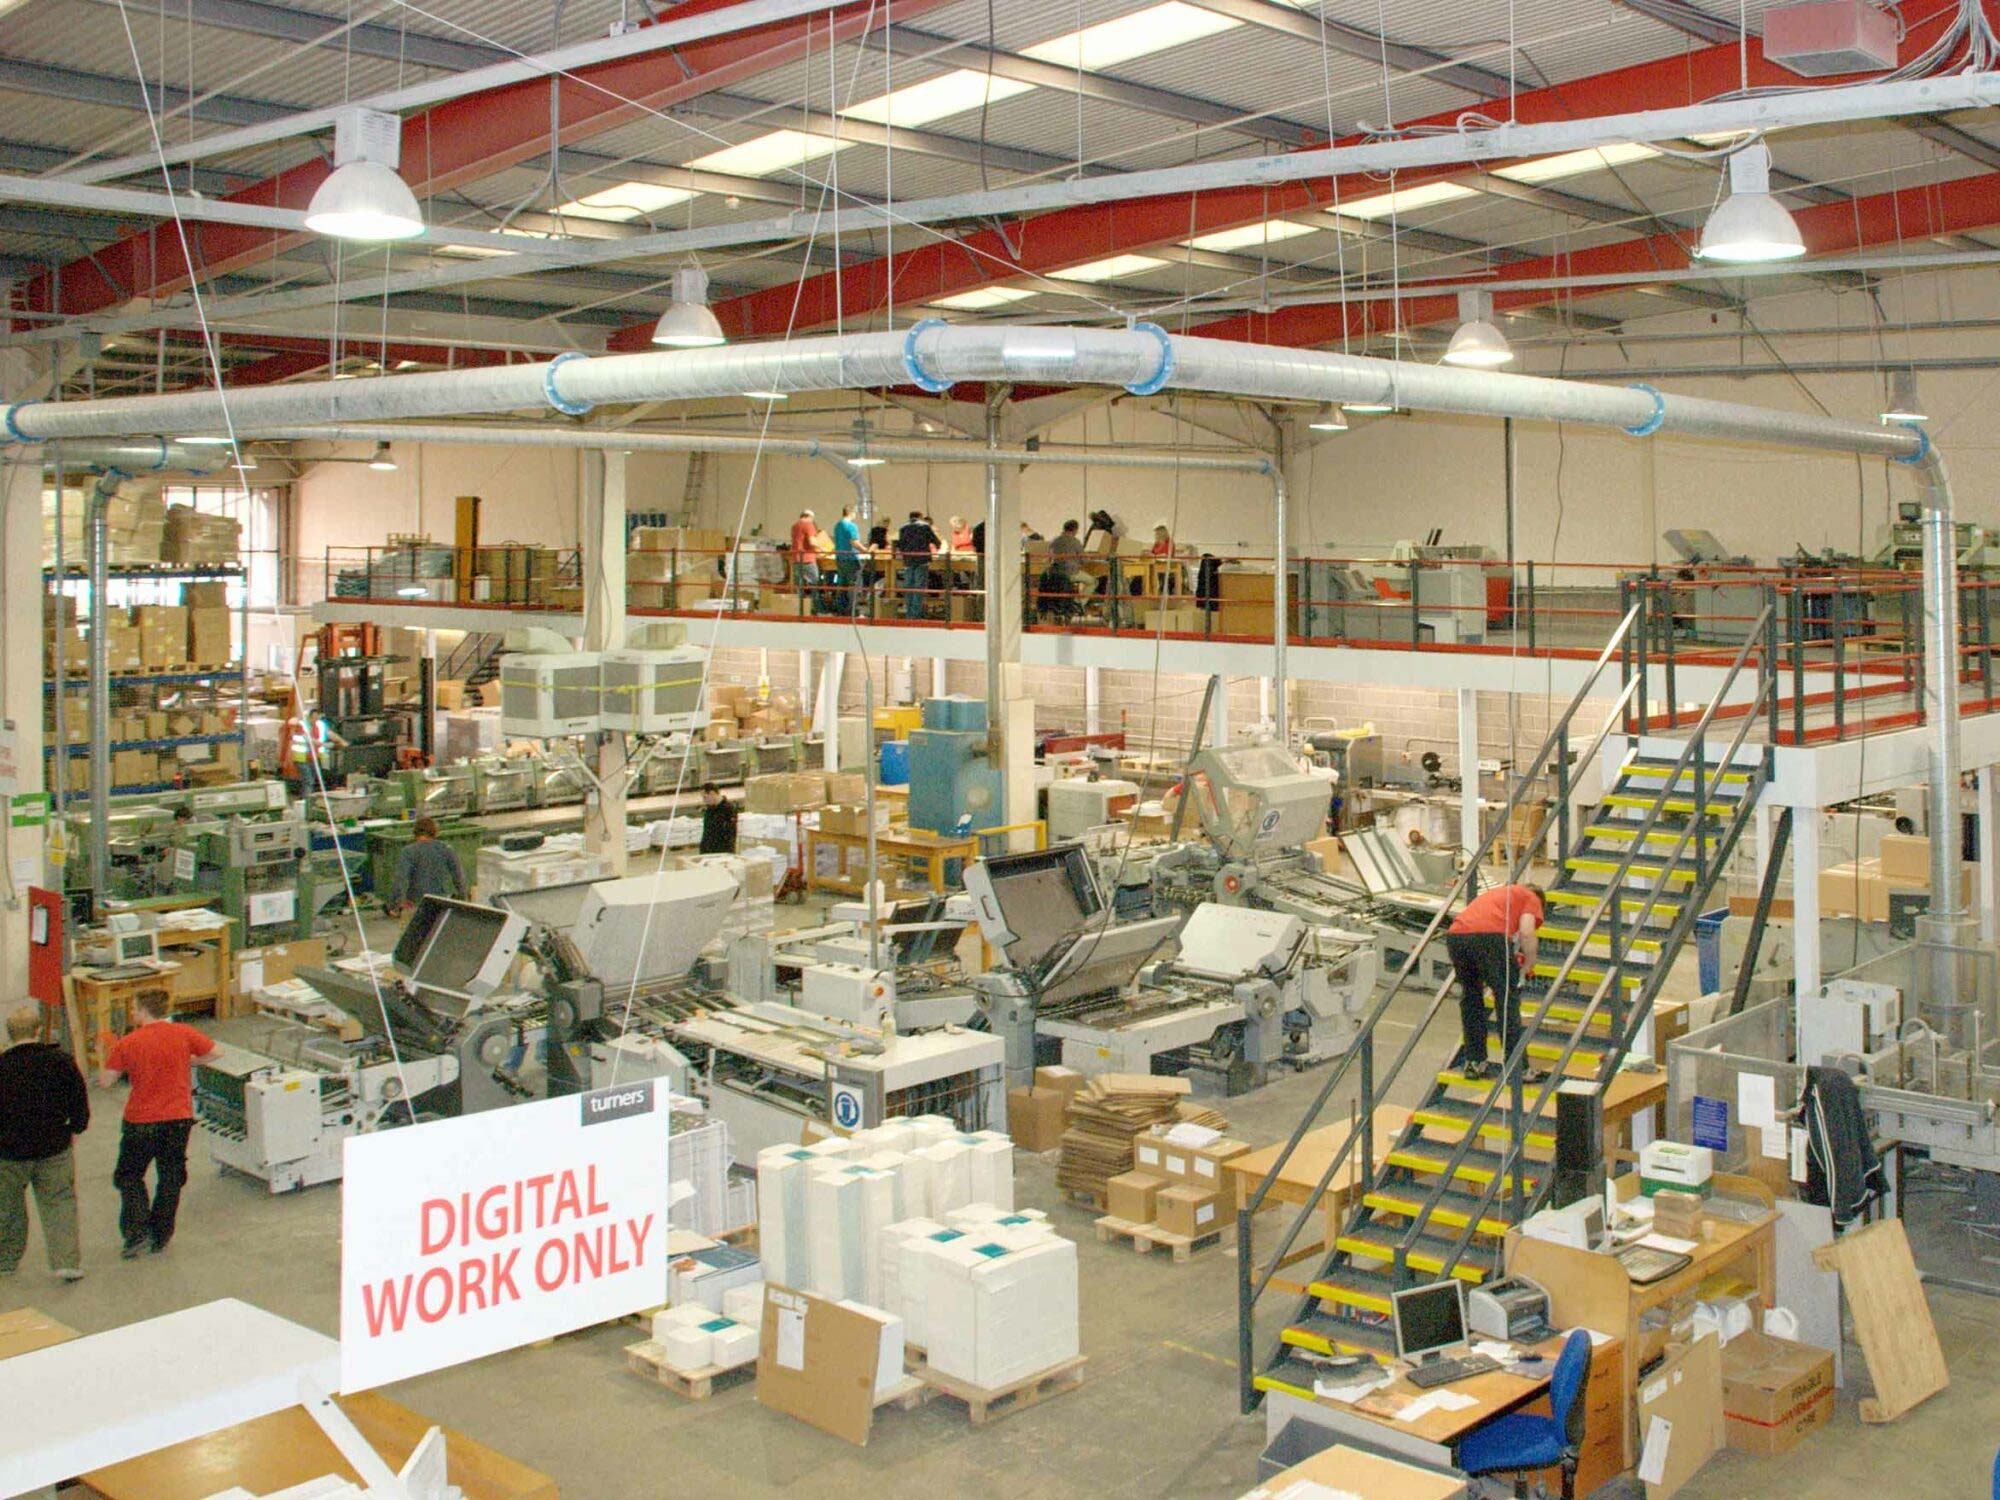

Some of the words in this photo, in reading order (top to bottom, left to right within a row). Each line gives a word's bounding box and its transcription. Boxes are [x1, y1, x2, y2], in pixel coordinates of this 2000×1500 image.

[590, 1089, 645, 1113] turners
[420, 1164, 609, 1257] DIGITAL
[362, 1247, 522, 1338] WORK
[535, 1213, 654, 1292] ONLY
